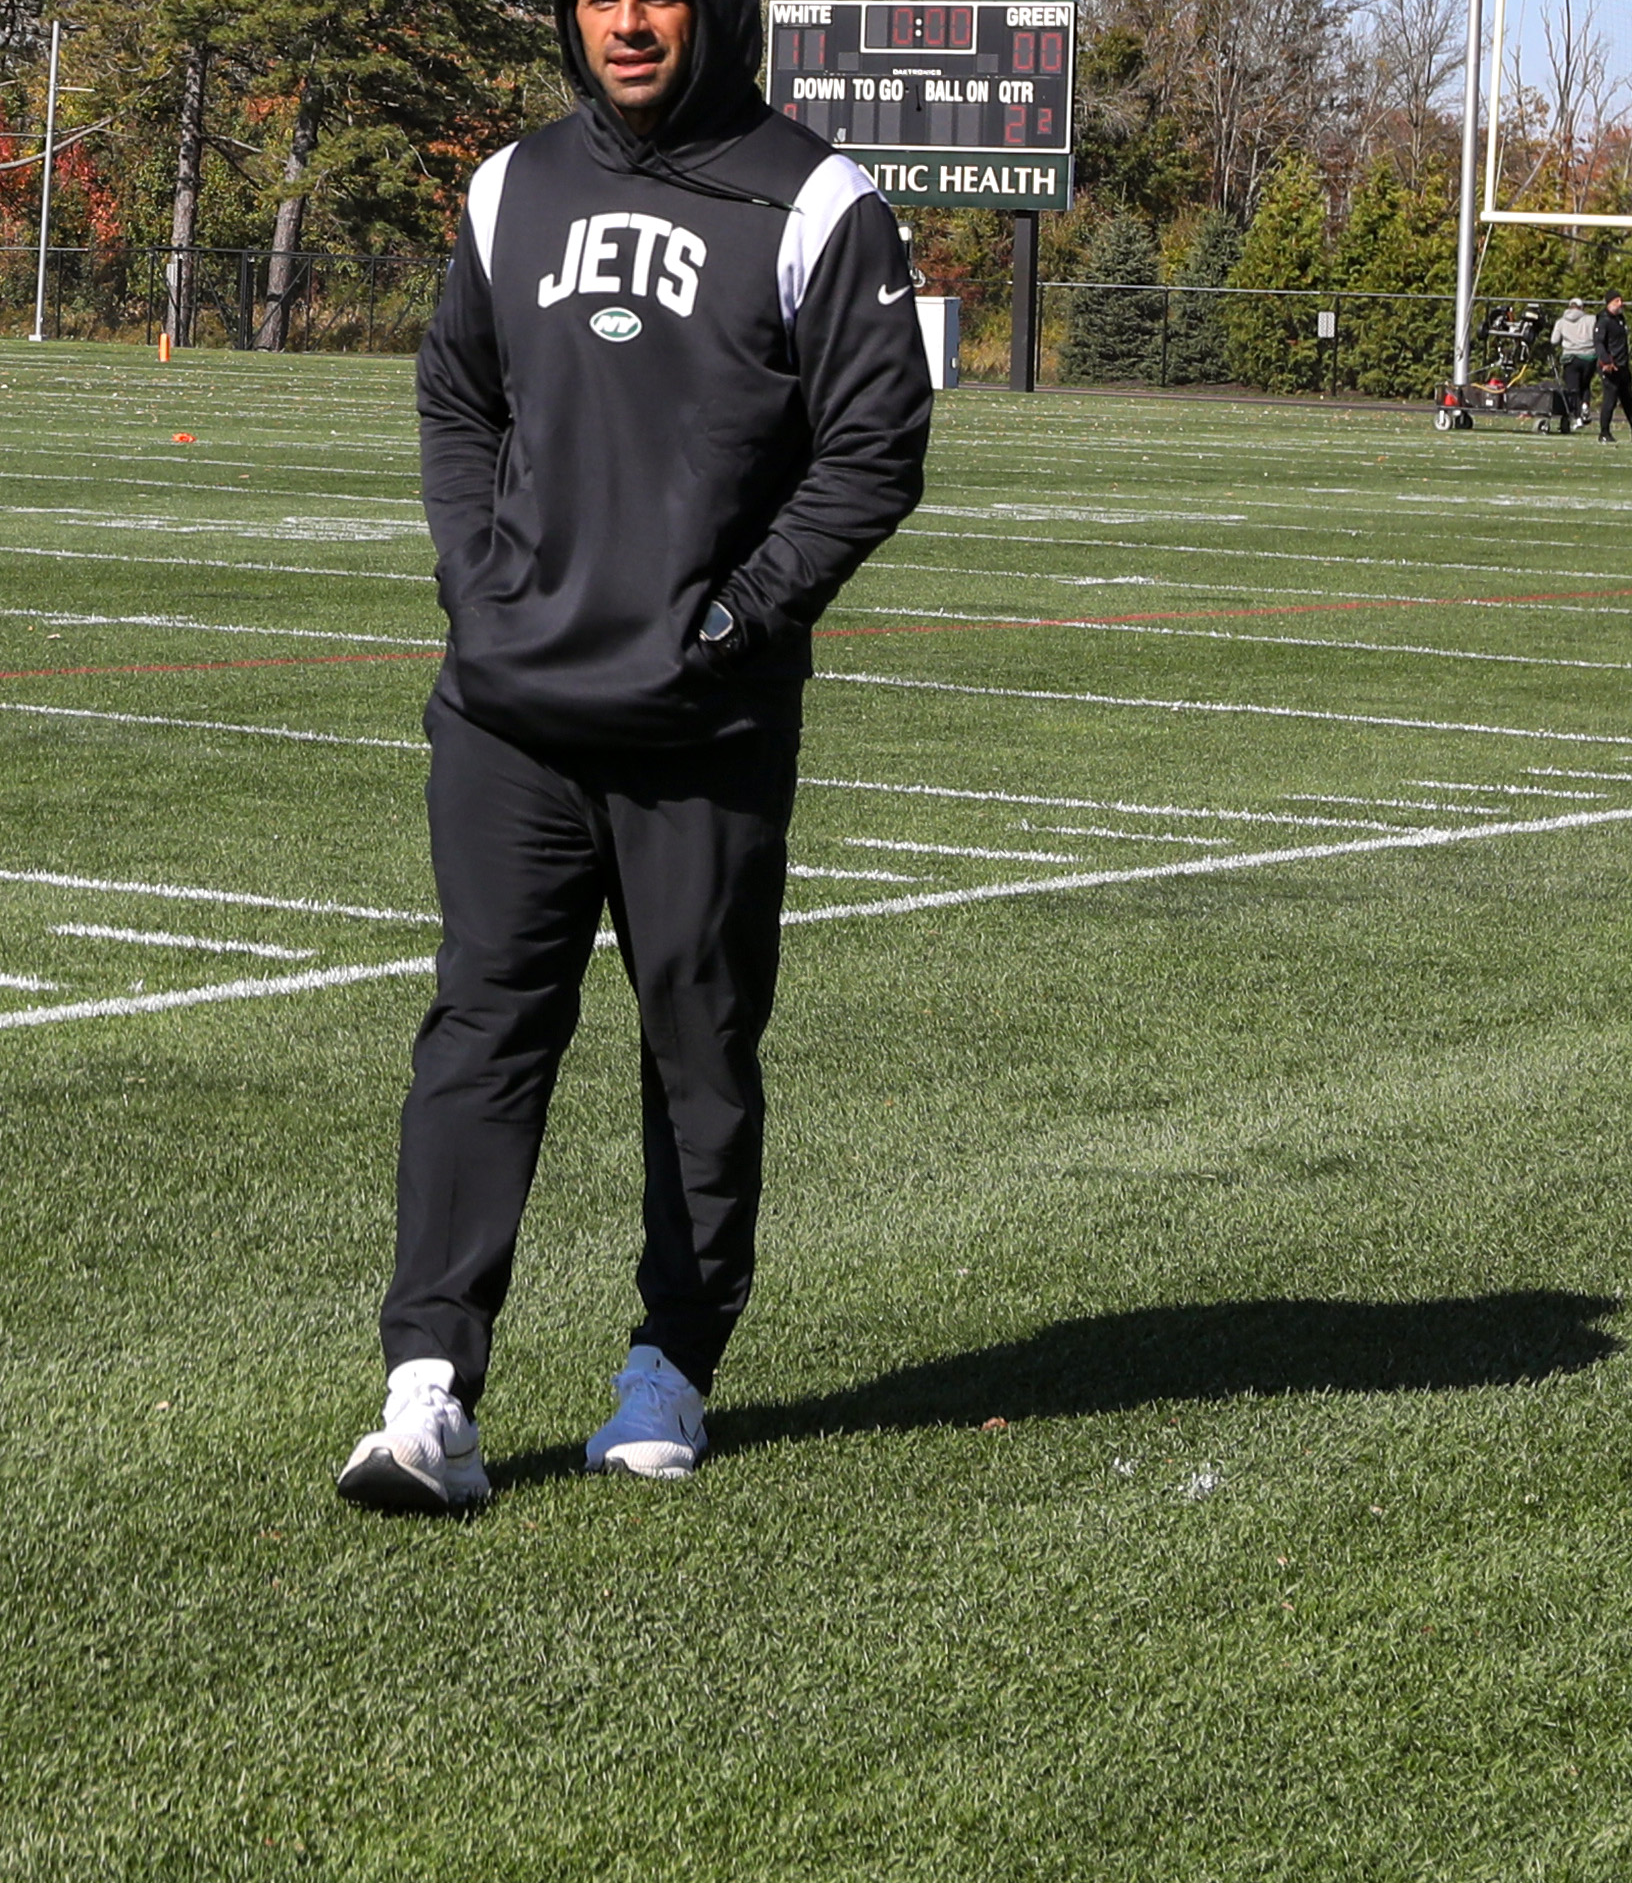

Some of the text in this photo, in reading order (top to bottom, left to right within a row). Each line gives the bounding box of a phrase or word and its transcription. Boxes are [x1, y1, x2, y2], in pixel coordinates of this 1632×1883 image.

[773, 5, 832, 25] WHITE
[892, 7, 972, 45] 0:00
[1006, 7, 1069, 27] GREEN
[793, 78, 846, 100] DOWN
[853, 79, 904, 101] TO GO
[925, 80, 989, 103] BALL ON
[999, 81, 1034, 103] QTR
[939, 166, 1056, 195] HEALTH
[537, 212, 708, 318] JETS
